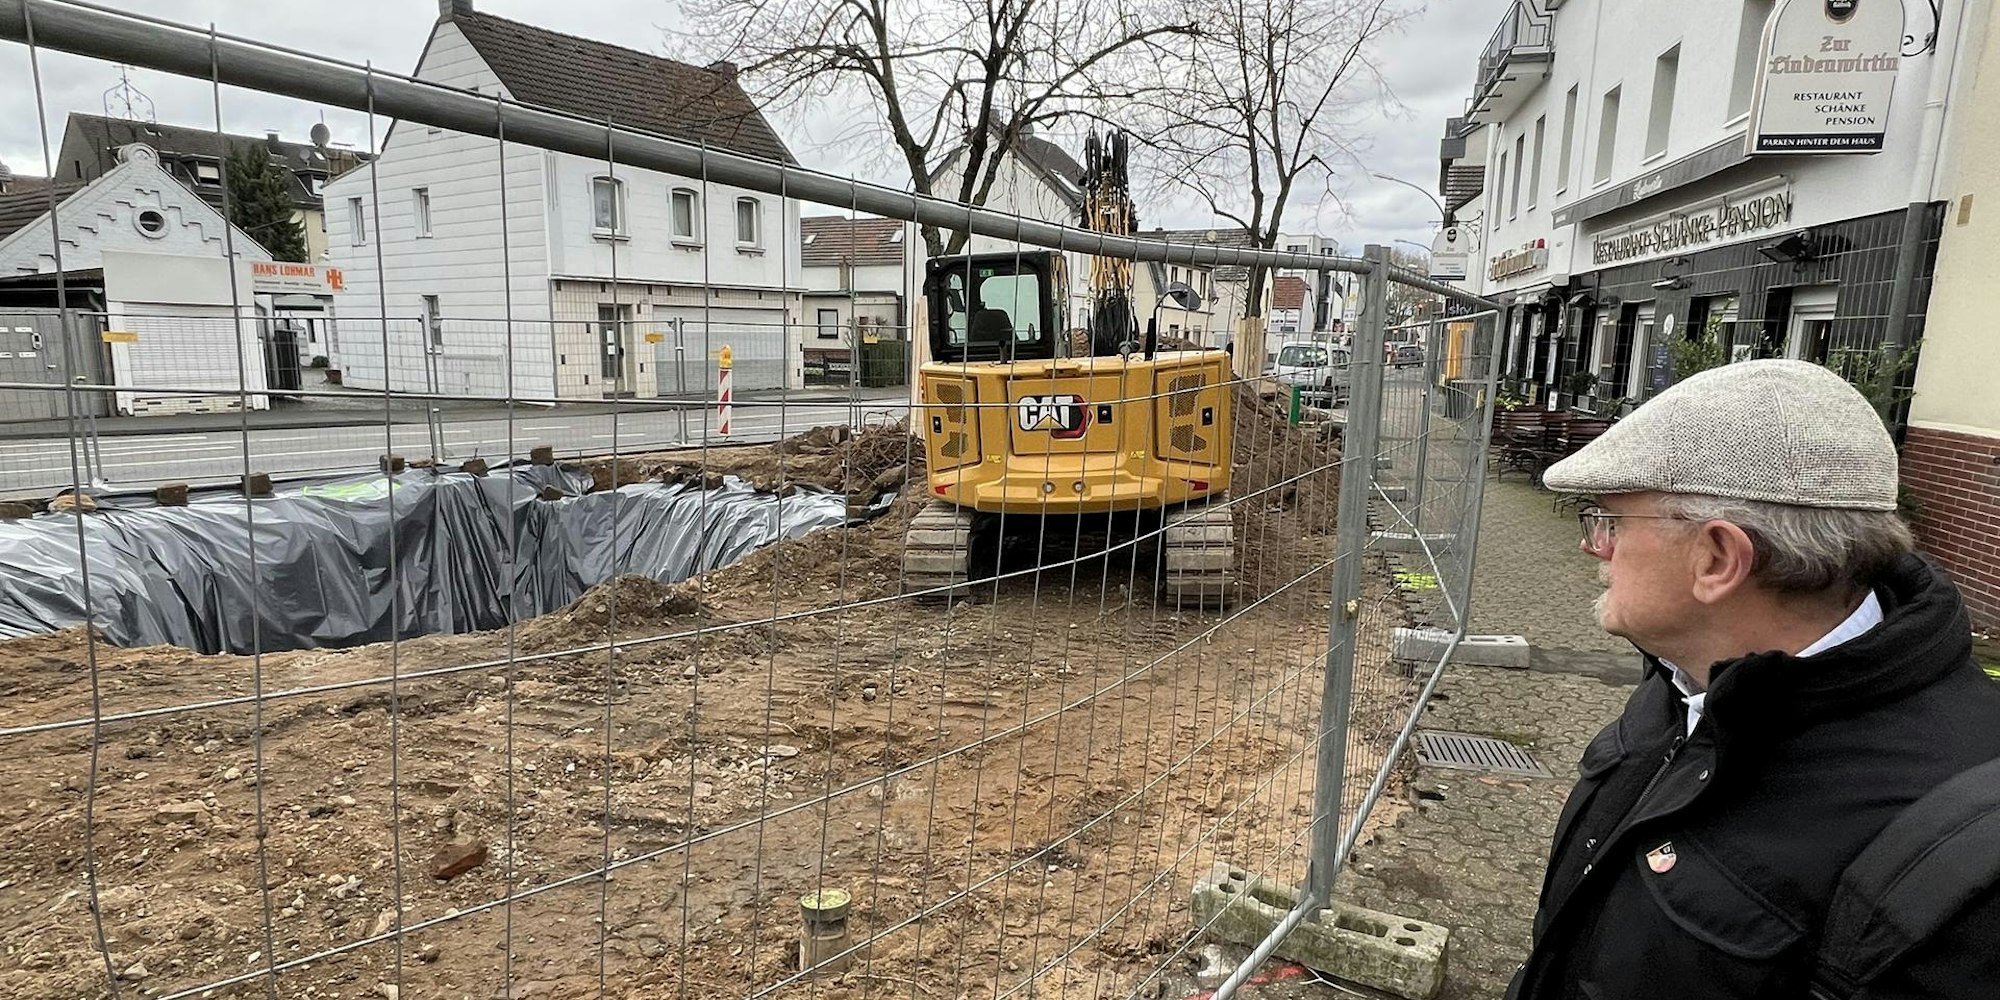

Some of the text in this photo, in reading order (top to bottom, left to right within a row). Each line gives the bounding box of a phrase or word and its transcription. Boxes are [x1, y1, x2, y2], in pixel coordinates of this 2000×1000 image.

[1820, 35, 1852, 53] Zur
[1769, 52, 1899, 75] Lindenwirtin
[1793, 91, 1863, 102] RESTAURANT
[1814, 102, 1867, 114] SCHÄNKE
[1825, 116, 1876, 126] PENSION
[1762, 137, 1876, 147] PARKEN HINTER DEM HAUS
[253, 263, 316, 277] HANS LOHMAR
[1019, 396, 1074, 431] CAT
